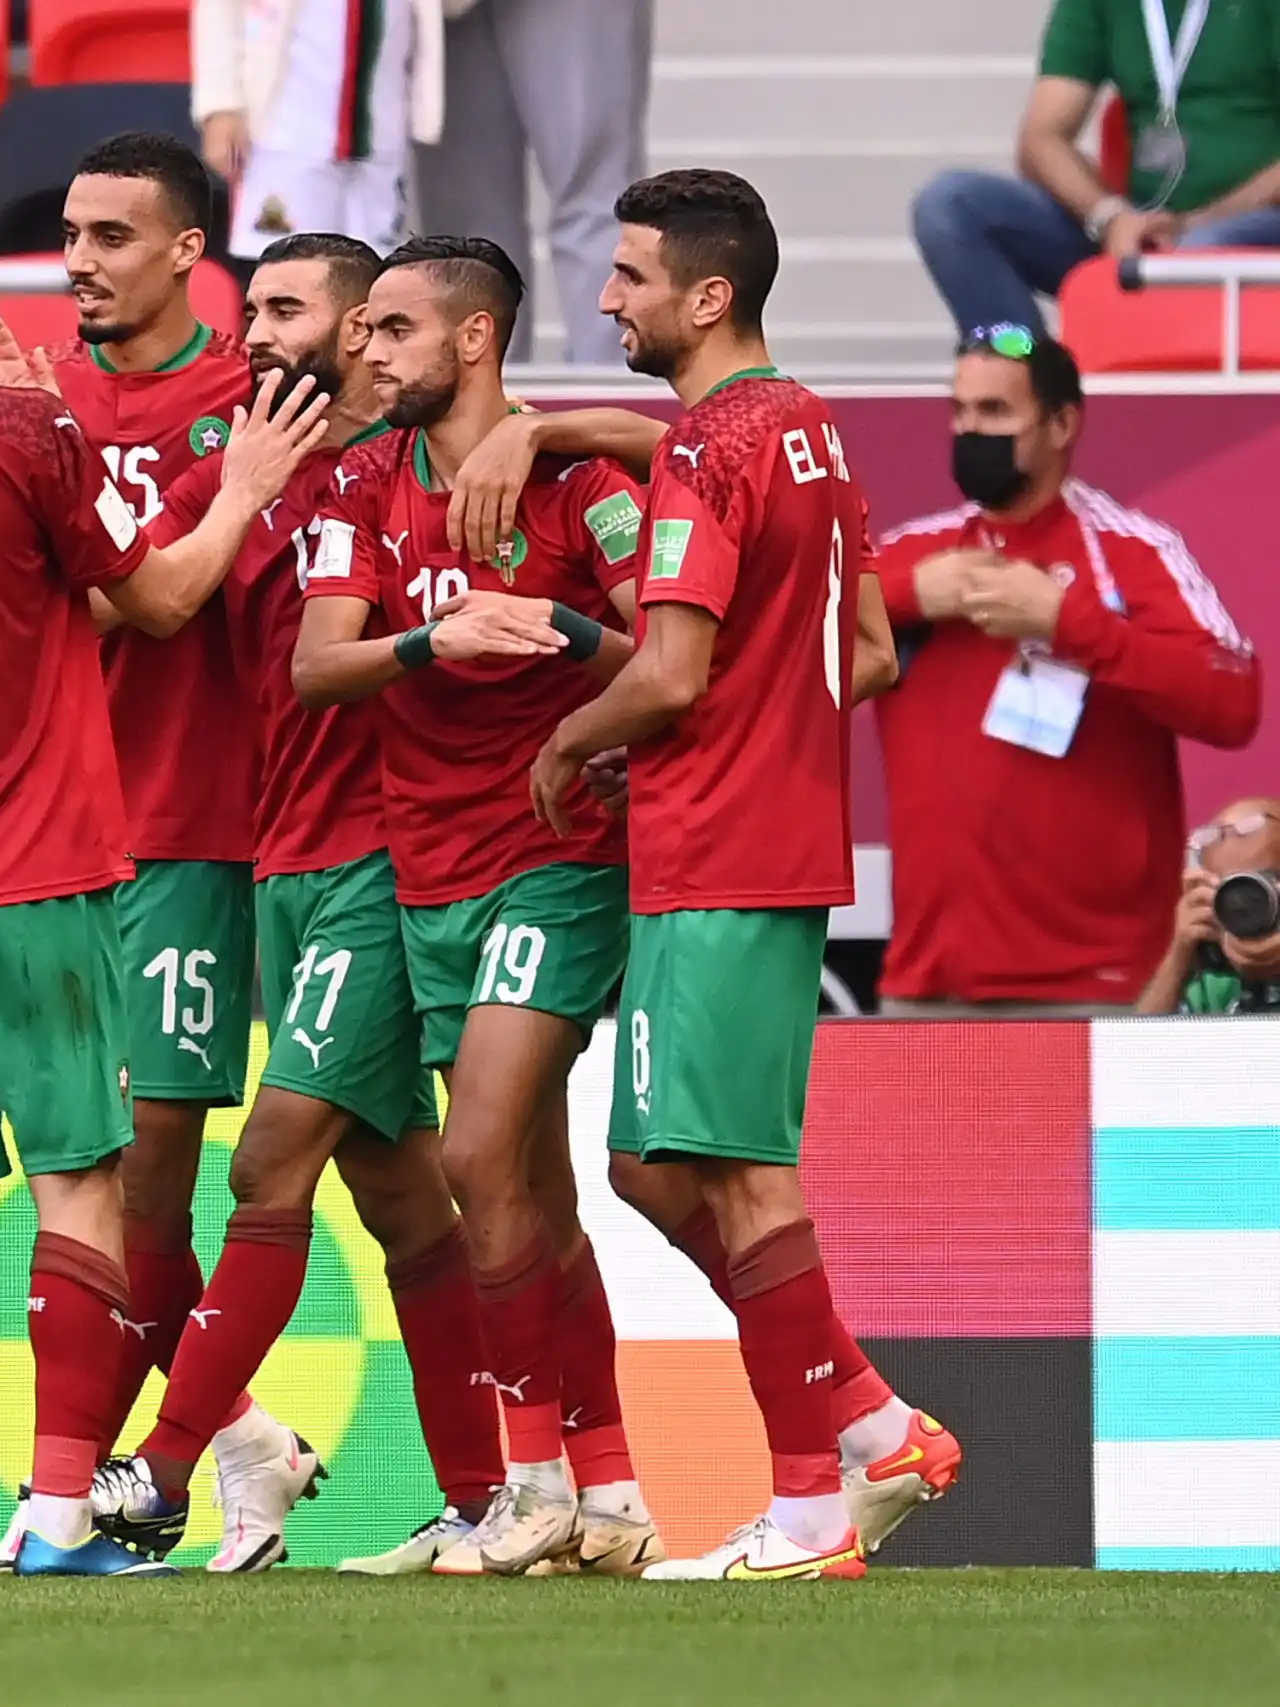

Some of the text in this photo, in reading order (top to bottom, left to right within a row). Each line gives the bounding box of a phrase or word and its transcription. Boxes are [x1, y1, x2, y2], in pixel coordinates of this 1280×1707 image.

[782, 428, 827, 484] EL
[143, 947, 217, 1035] 15
[478, 923, 546, 1004] 19
[631, 1009, 650, 1096] 8
